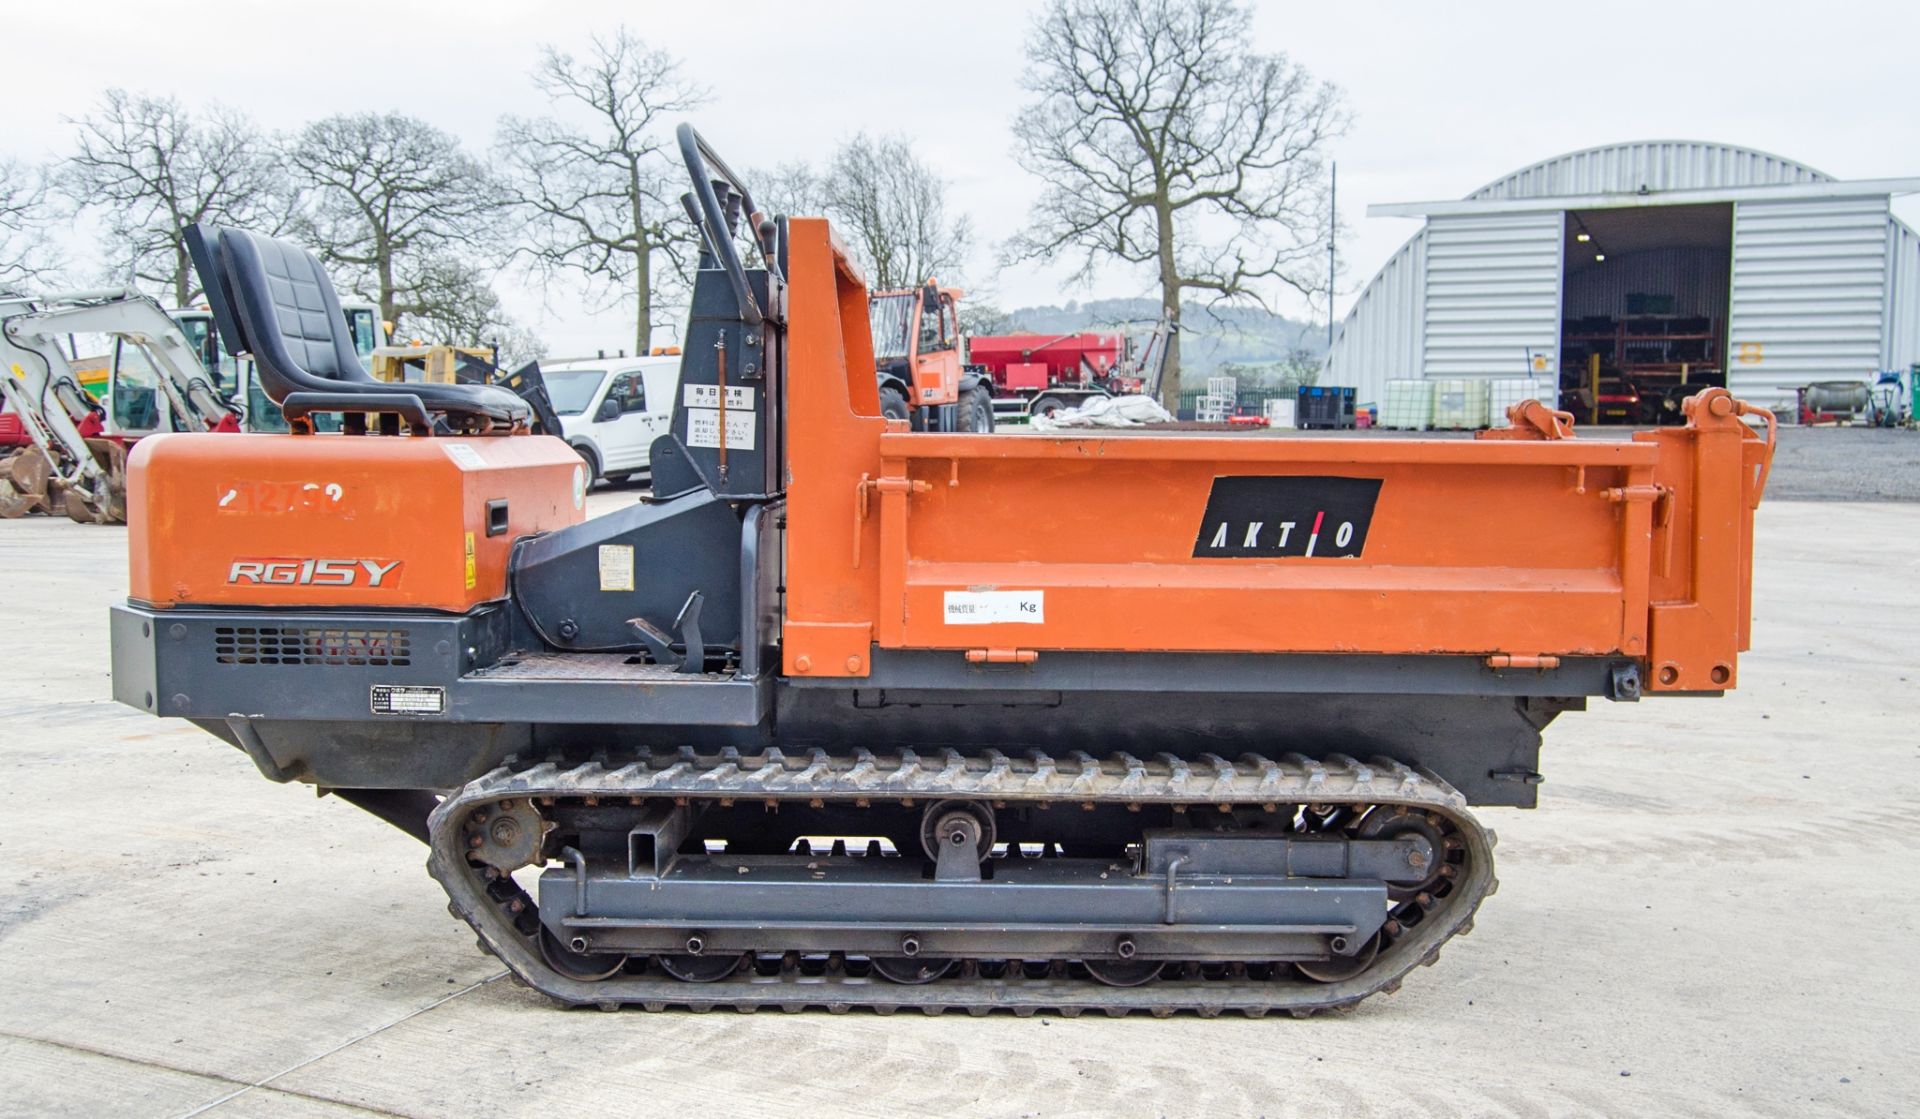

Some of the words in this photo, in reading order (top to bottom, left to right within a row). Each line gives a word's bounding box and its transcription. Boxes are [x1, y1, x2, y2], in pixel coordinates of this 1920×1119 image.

[1210, 511, 1354, 558] AKTIO
[228, 559, 401, 587] RG15Y
[1020, 601, 1037, 613] Kg
